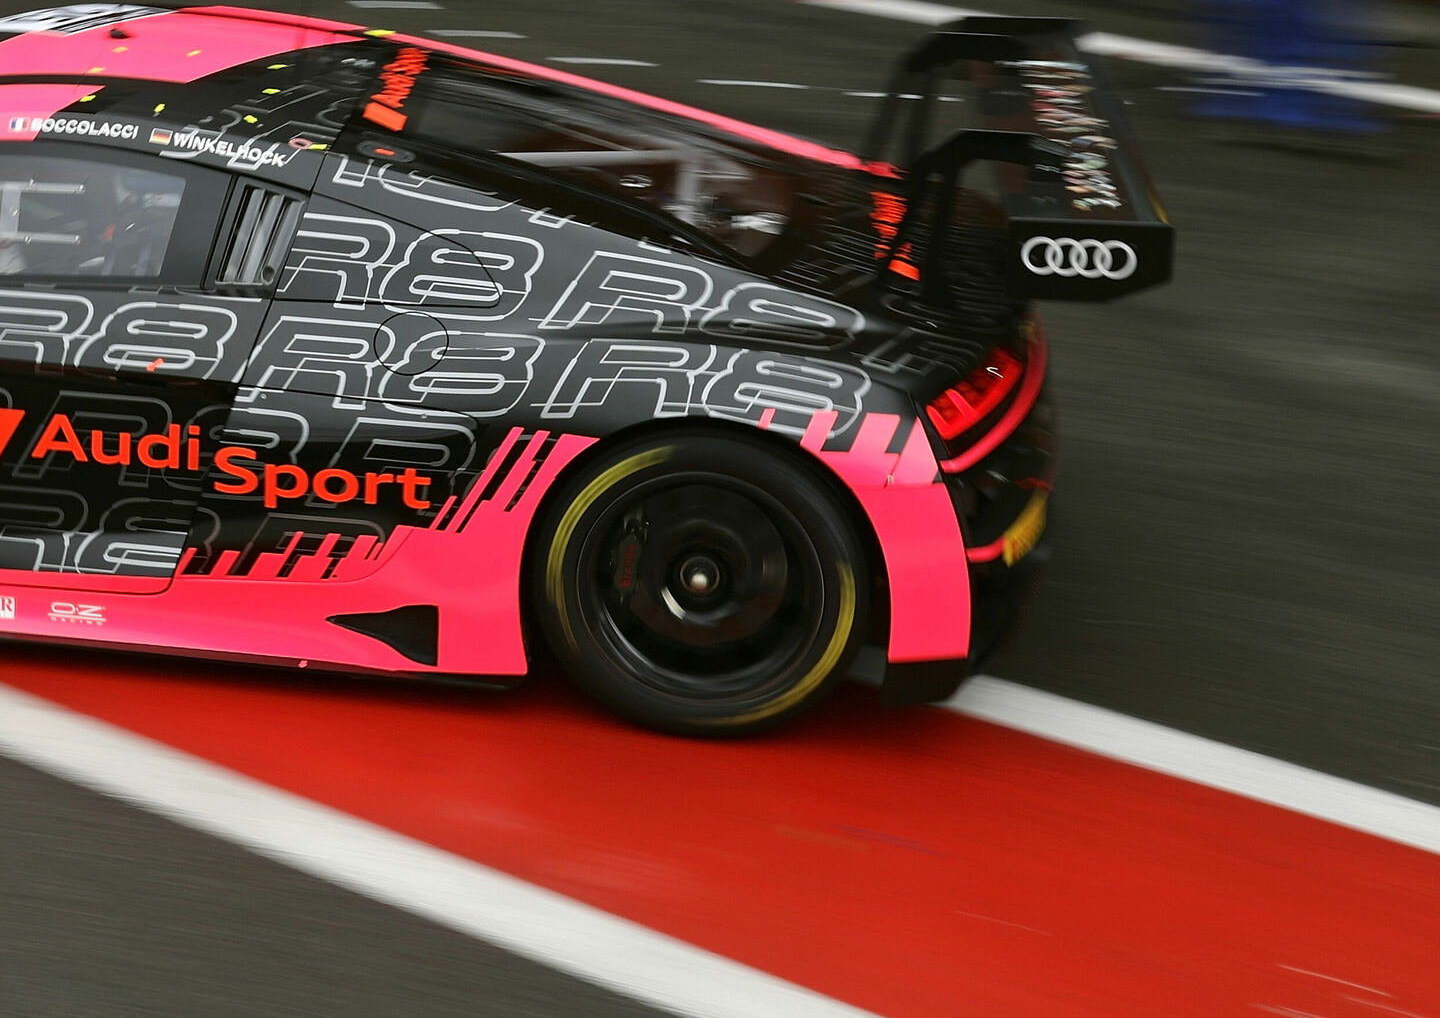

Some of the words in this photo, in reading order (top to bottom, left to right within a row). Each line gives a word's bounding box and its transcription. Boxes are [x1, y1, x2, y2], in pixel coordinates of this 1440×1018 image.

[30, 118, 139, 140] BOCCOLACCI
[173, 132, 288, 168] WINKELHOCK
[235, 316, 546, 419] R8
[538, 339, 872, 439] R8
[31, 413, 201, 471] Audi
[213, 446, 432, 510] Sport
